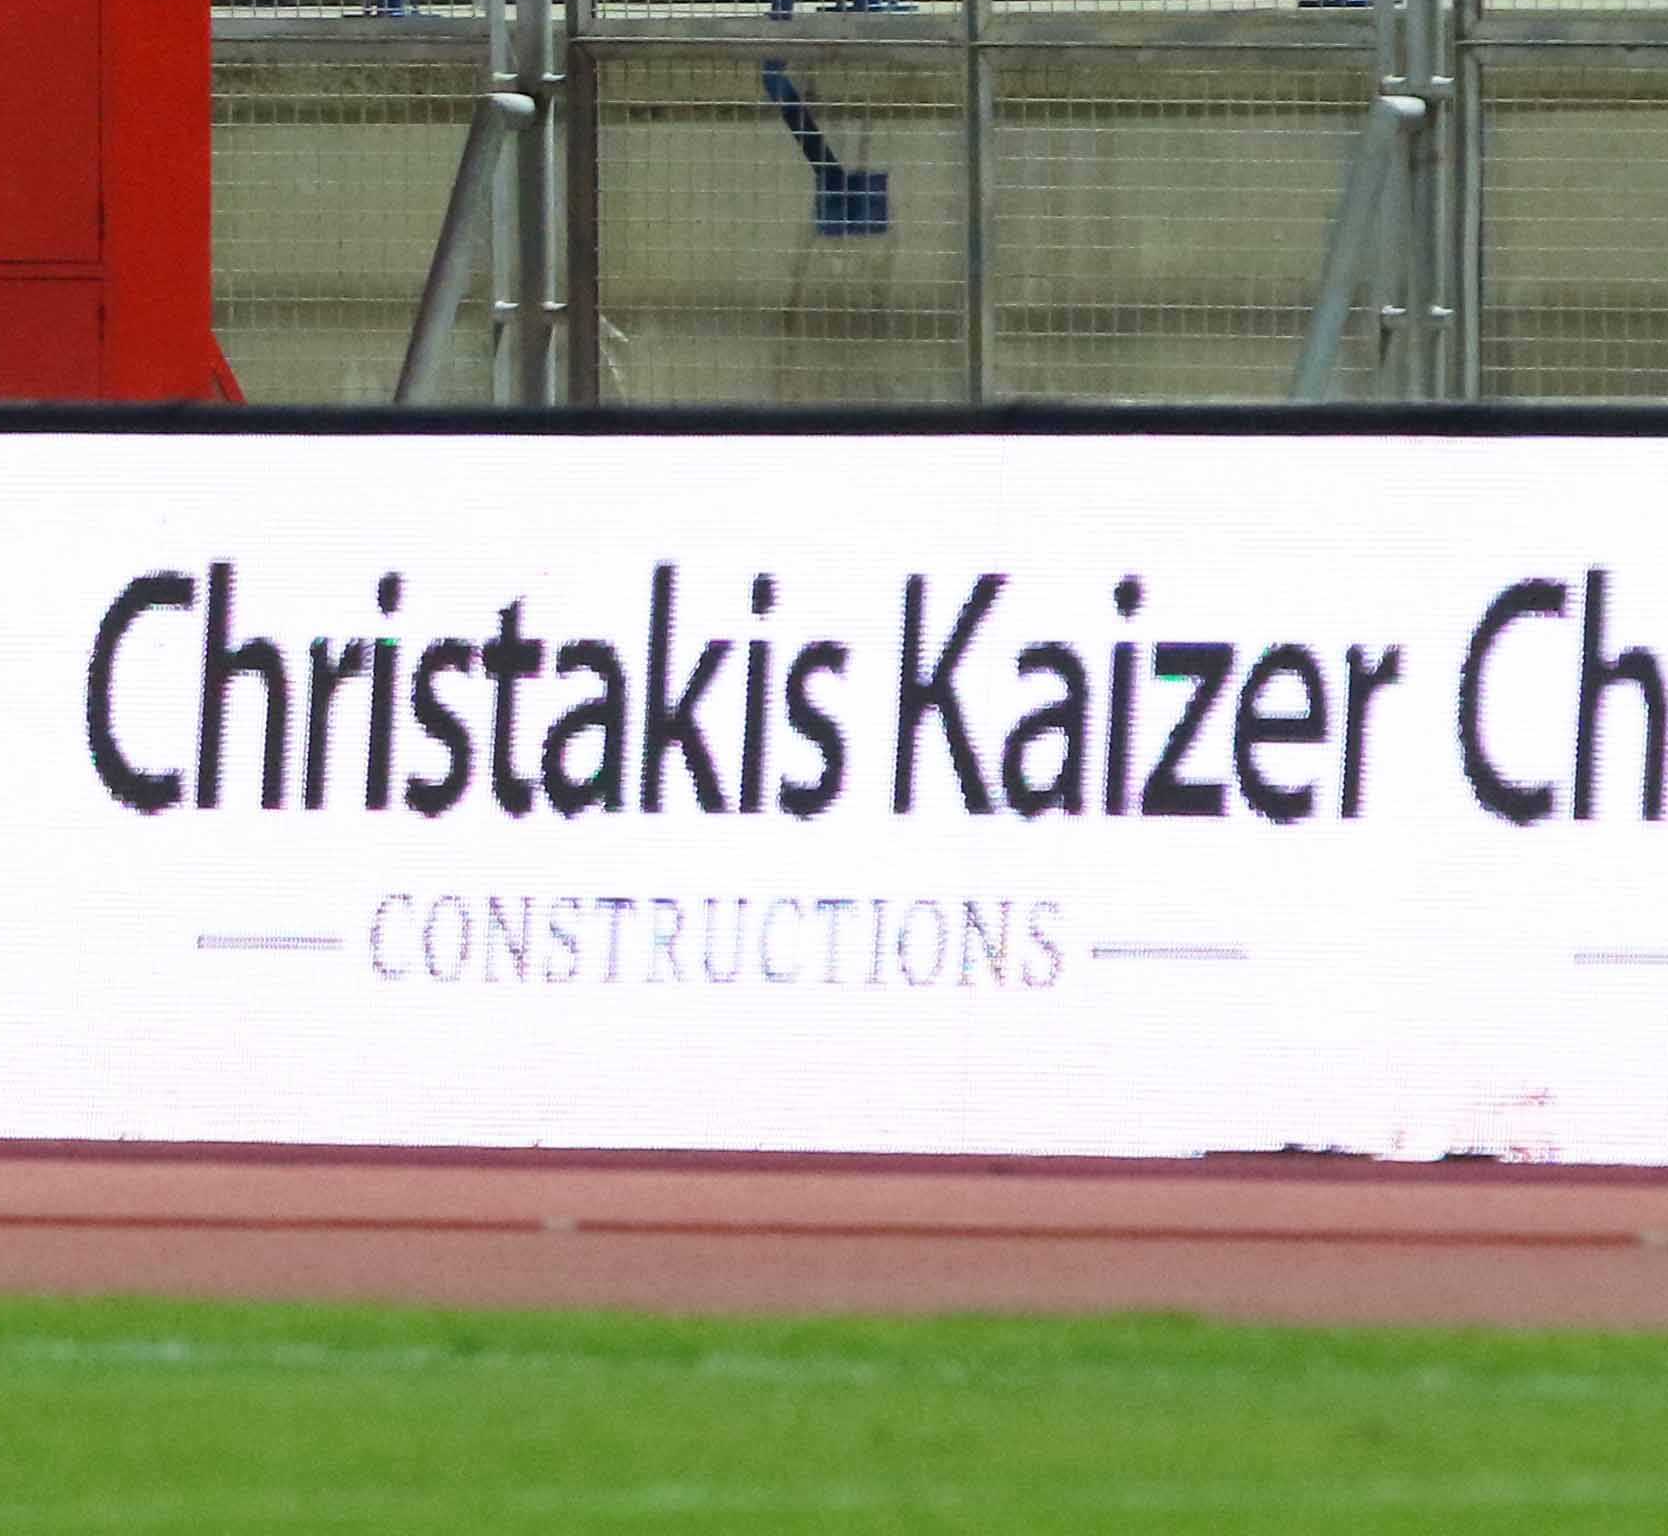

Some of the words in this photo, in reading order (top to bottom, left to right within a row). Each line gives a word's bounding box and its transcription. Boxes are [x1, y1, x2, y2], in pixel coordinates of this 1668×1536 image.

[86, 561, 847, 820] Christakis
[893, 574, 1401, 824] Kaizer
[369, 894, 1061, 987] CONSTRUCTIONS
